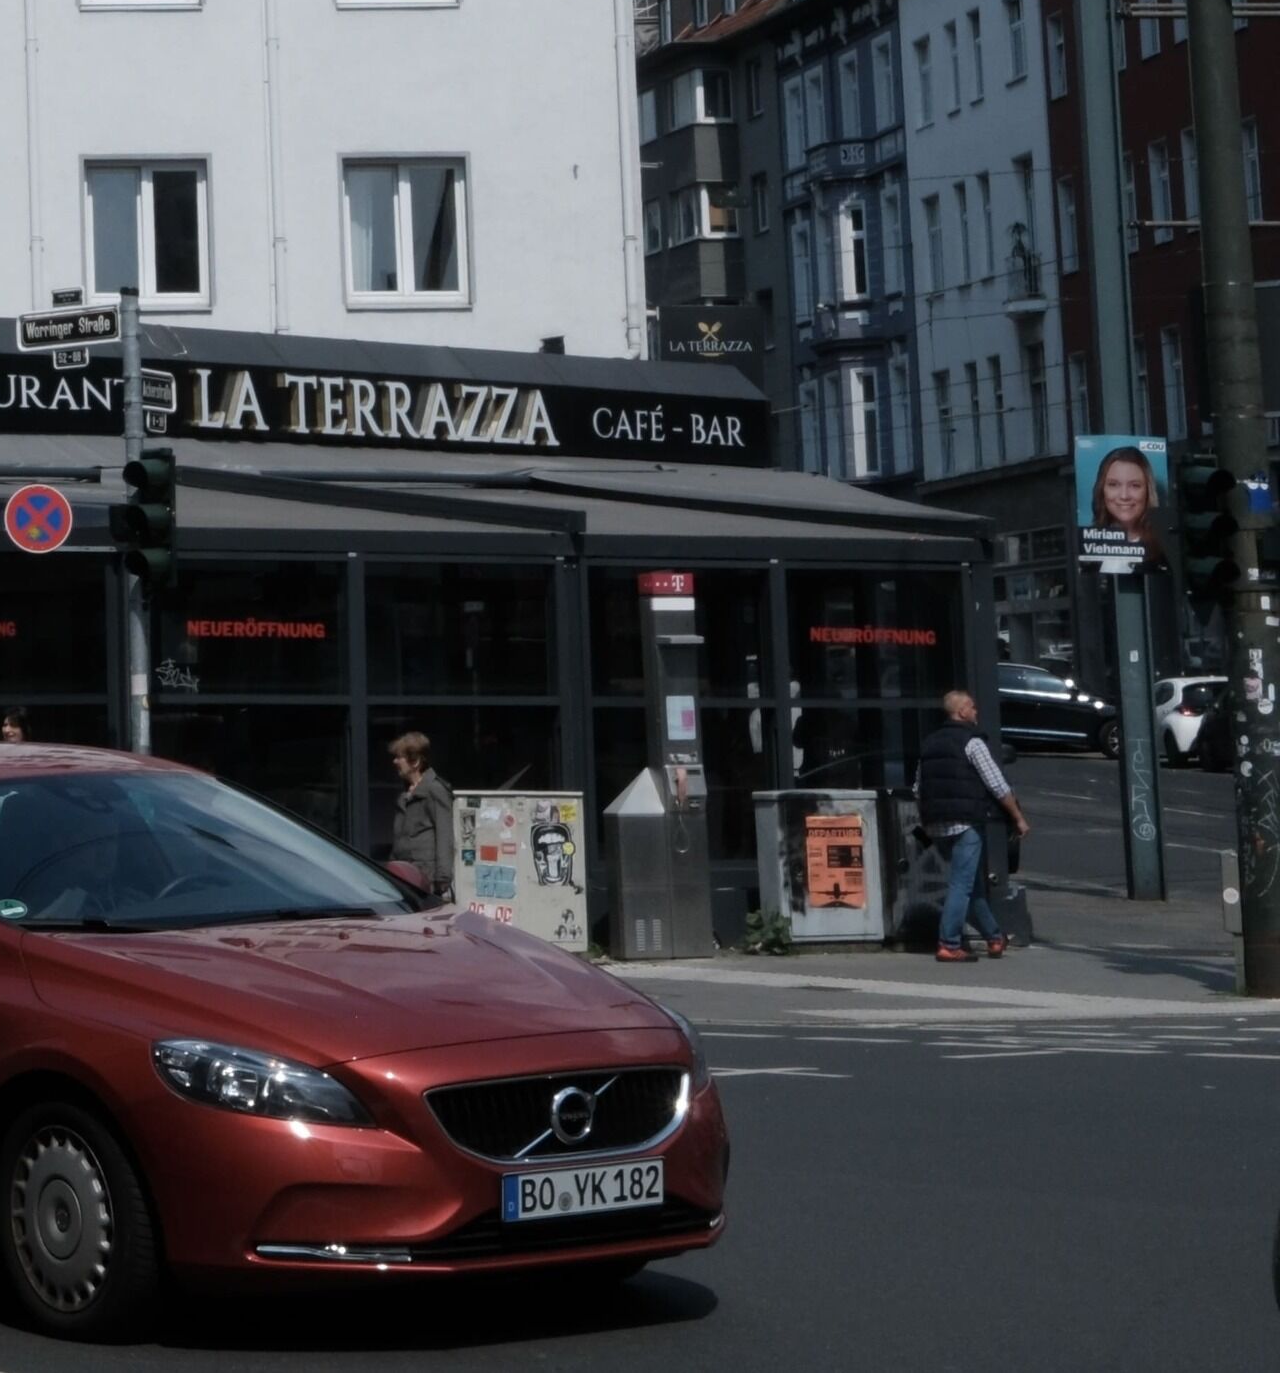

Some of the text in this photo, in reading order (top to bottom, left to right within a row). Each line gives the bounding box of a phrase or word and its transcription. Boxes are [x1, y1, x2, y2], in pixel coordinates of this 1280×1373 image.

[25, 315, 111, 340] Worringer Straße
[669, 340, 753, 352] LA TERRAZZA
[194, 368, 560, 446] LA TERRAZZA
[592, 404, 665, 442] CAFÉ
[690, 413, 746, 447] BAR
[1146, 443, 1165, 451] CDU
[1083, 528, 1125, 540] Miriam
[1083, 543, 1146, 556] Viehmann
[186, 617, 326, 639] NEUERÖFFNUNG
[810, 624, 937, 645] NEUERÖFFNUNG
[521, 1177, 555, 1214] BO
[574, 1170, 608, 1206] YK
[613, 1165, 660, 1203] 182
